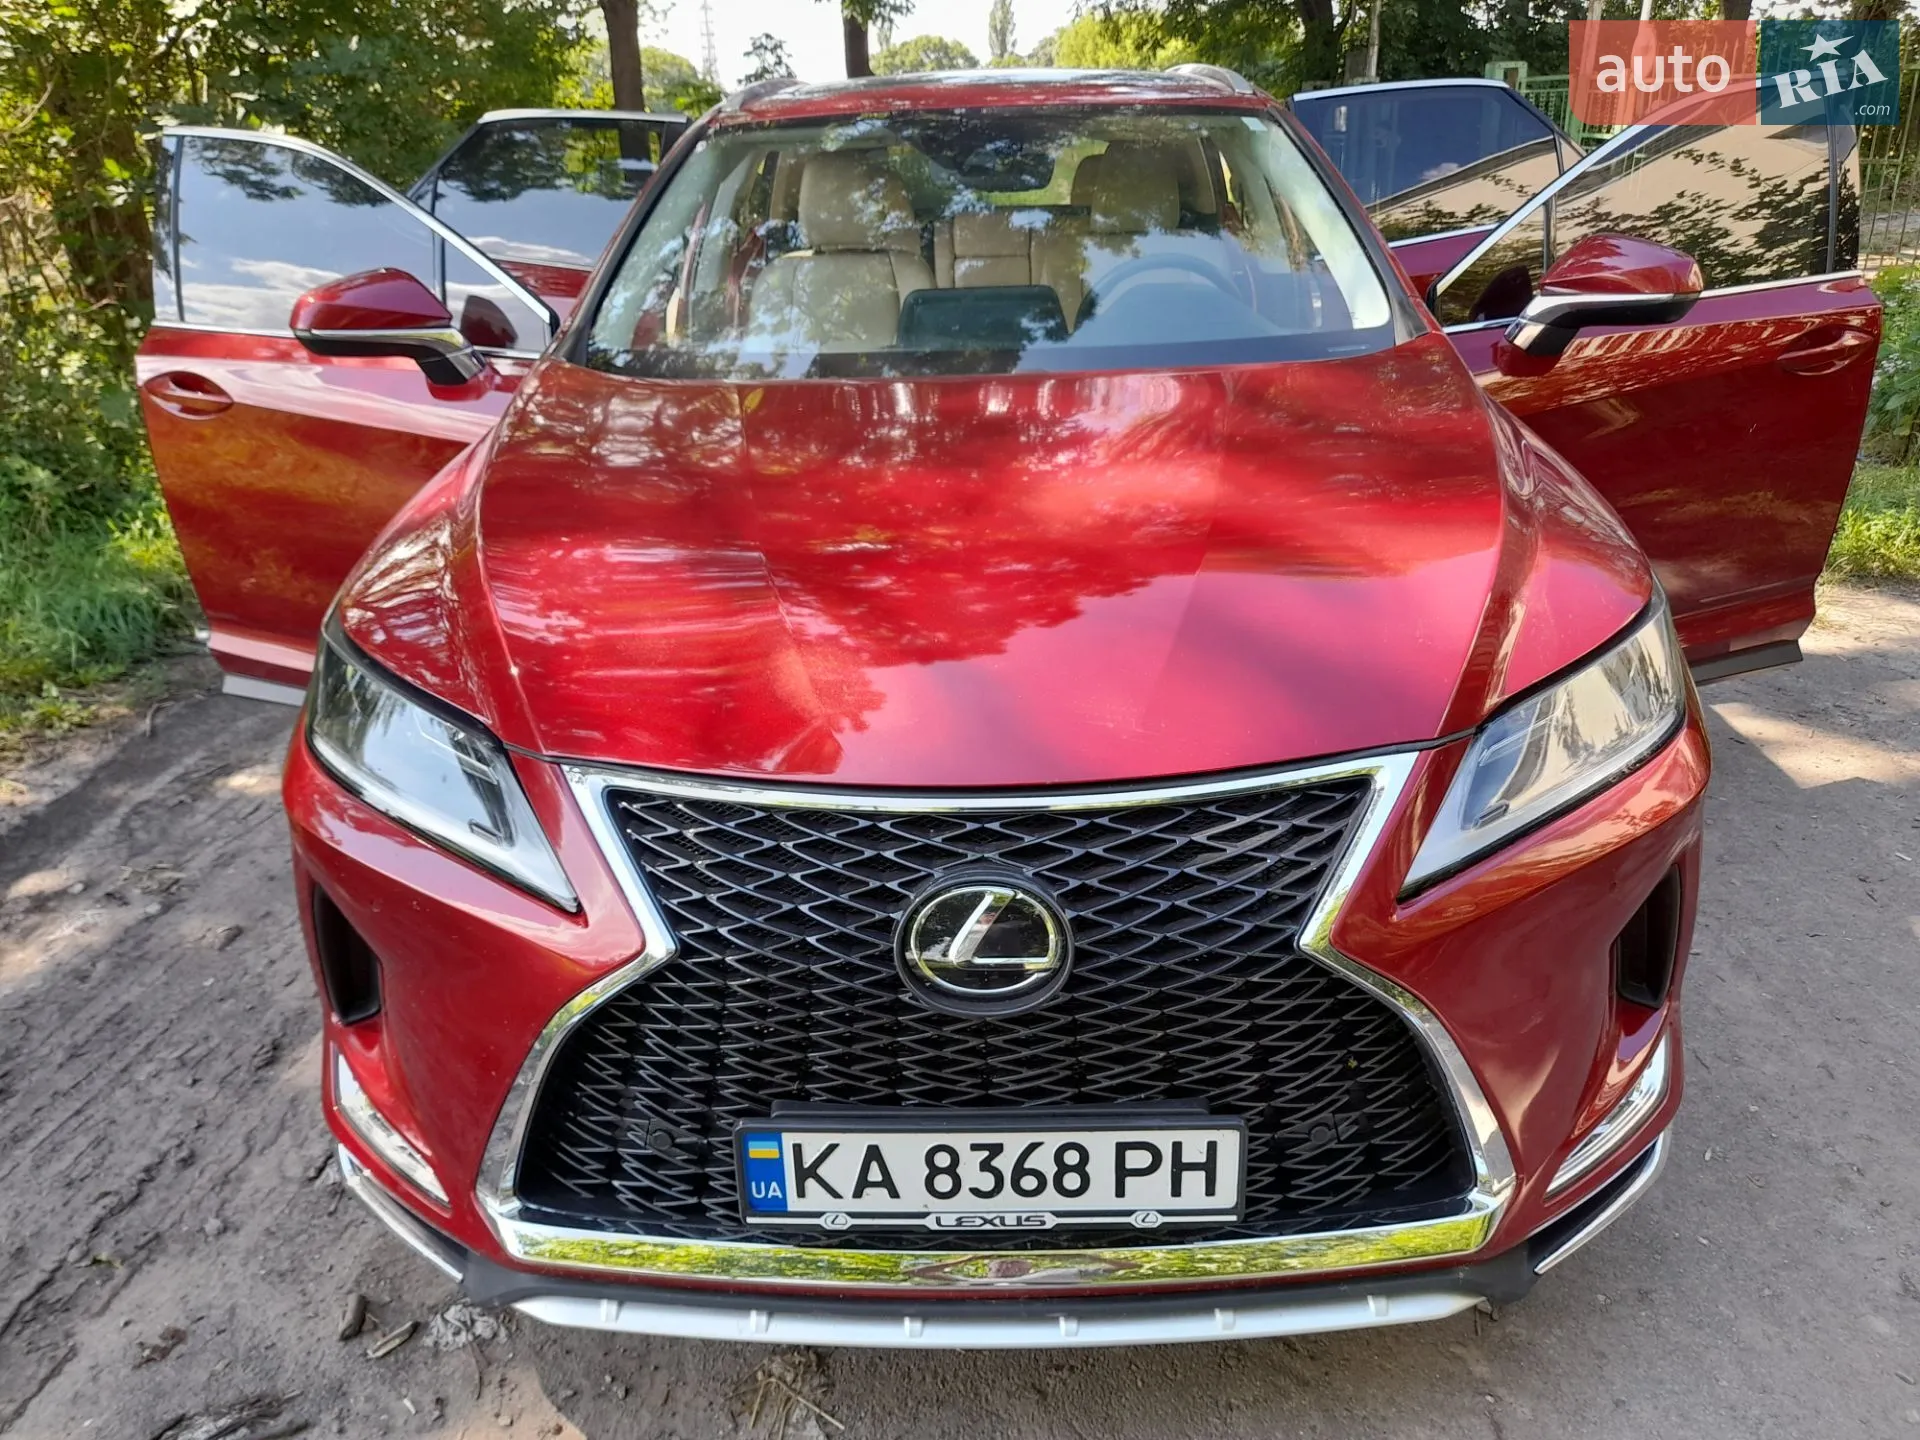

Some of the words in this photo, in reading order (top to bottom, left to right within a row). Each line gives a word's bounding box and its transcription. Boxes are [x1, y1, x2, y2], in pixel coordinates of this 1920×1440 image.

[791, 1142, 900, 1199] KA
[924, 1141, 1090, 1199] 8368
[1114, 1140, 1218, 1198] PH
[751, 1181, 783, 1199] UA
[935, 1215, 1047, 1228] LEXUS
